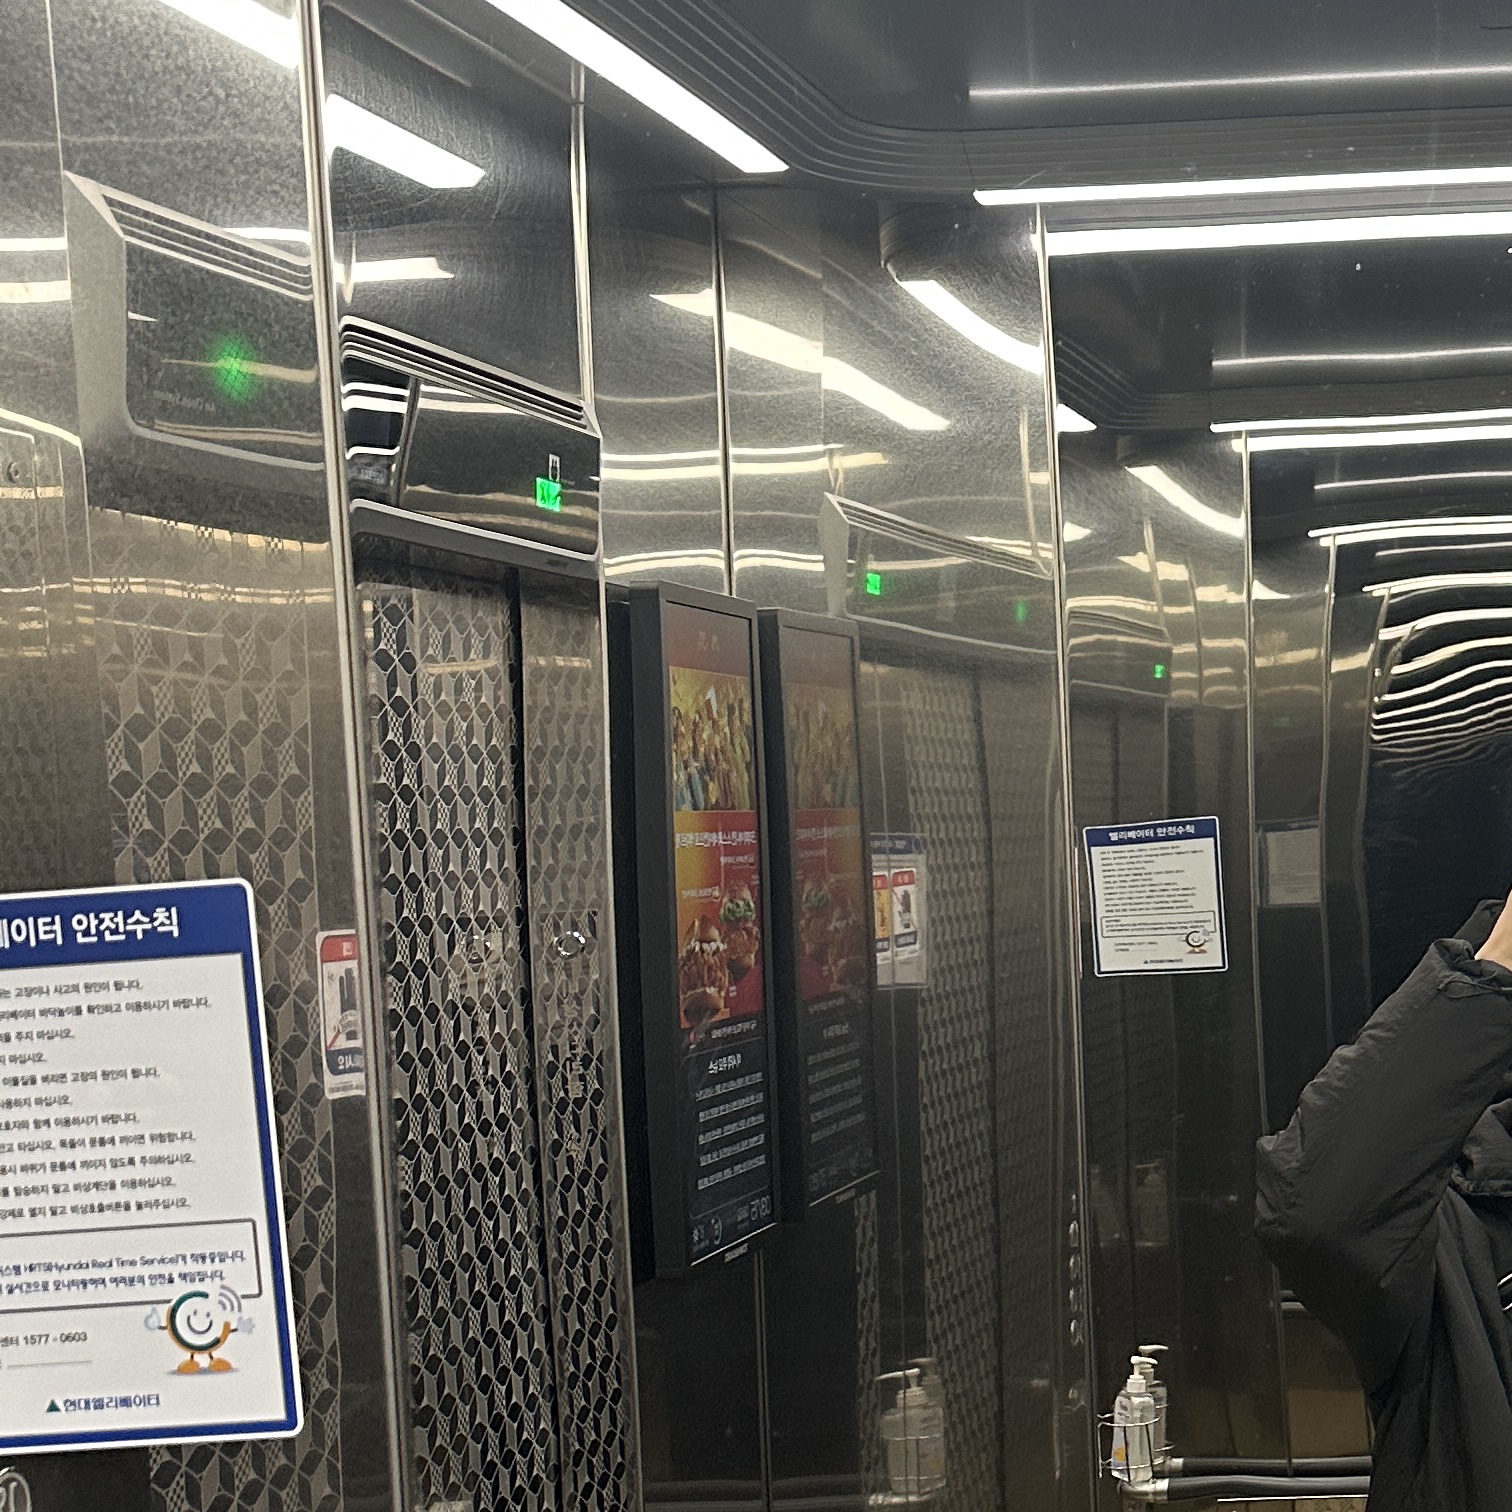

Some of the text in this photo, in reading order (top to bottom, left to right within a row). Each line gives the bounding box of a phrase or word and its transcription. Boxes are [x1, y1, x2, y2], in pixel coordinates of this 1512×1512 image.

[71, 907, 180, 944] 안전수칙
[23, 1334, 50, 1346] 1577
[59, 1331, 88, 1343] 0603
[63, 1393, 160, 1412] 현대엘리베이터
